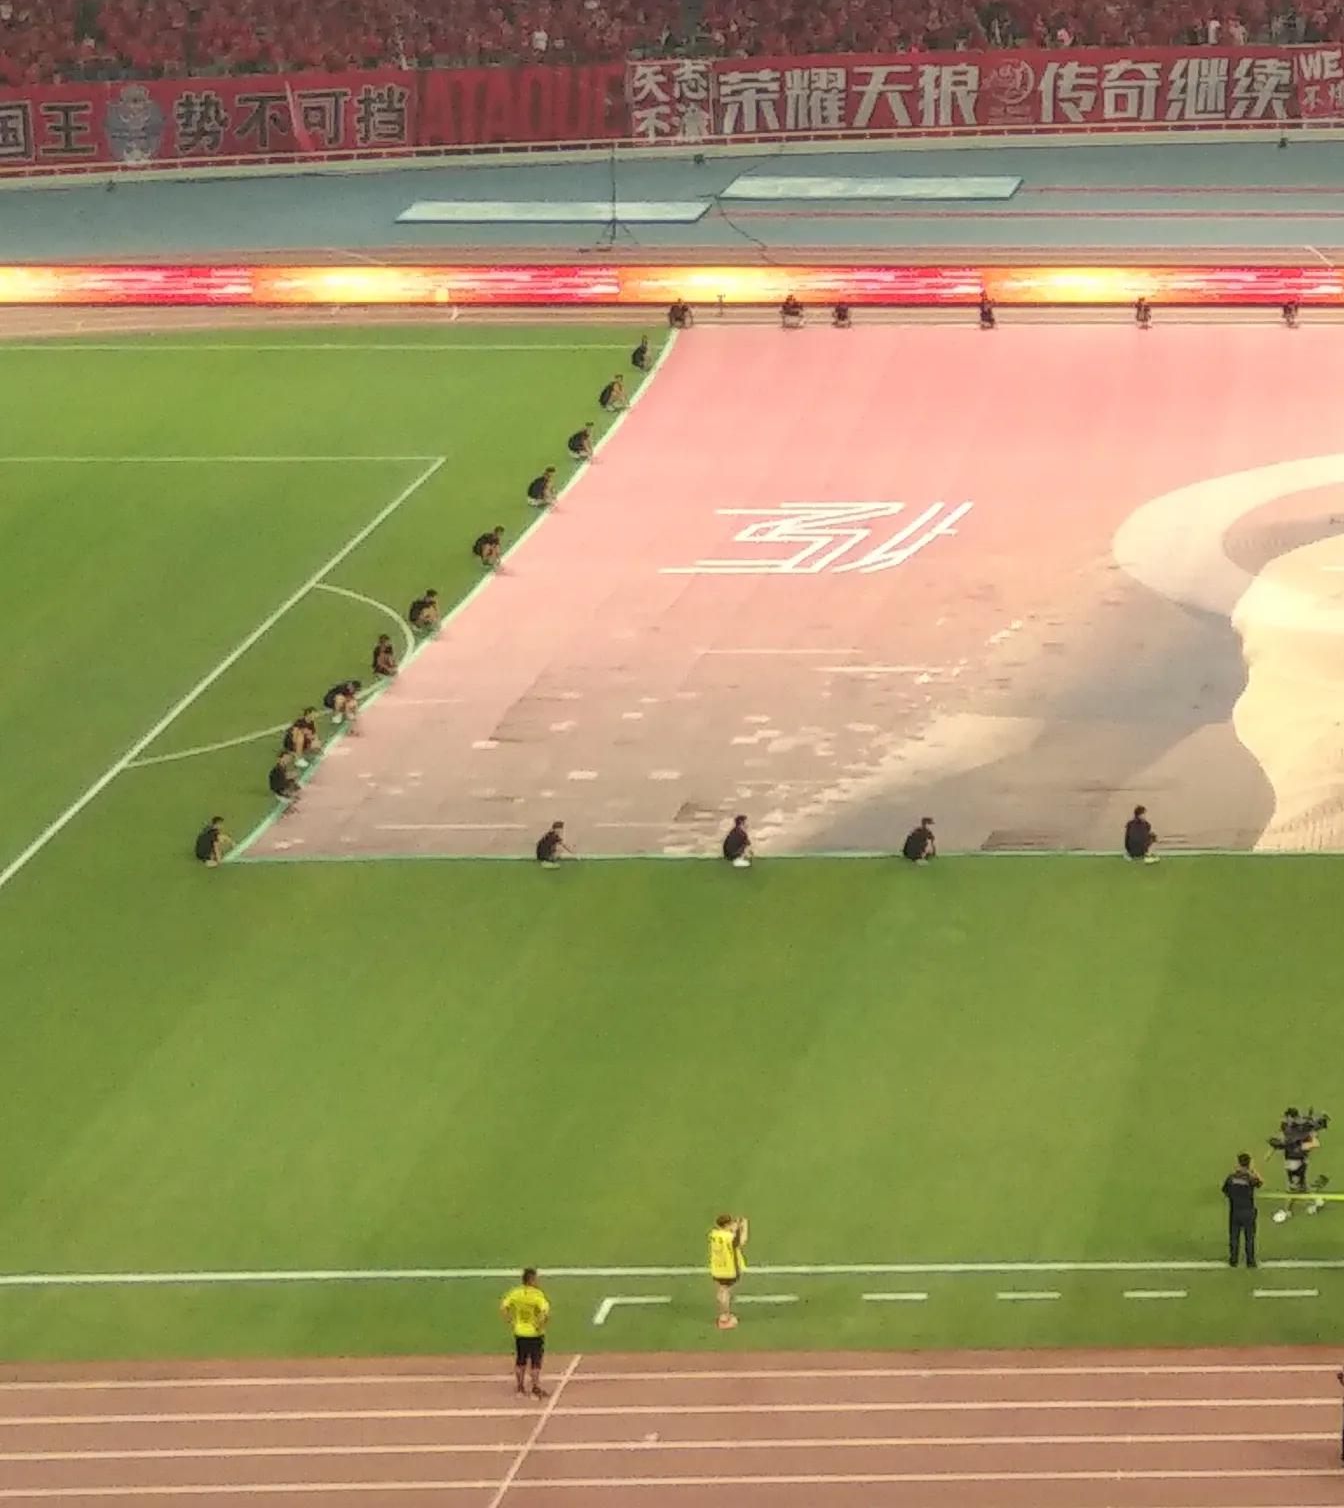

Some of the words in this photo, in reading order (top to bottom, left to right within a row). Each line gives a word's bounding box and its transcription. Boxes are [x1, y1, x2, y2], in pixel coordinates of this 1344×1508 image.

[718, 62, 979, 134] 荣耀天狼
[1039, 56, 1294, 124] 传奇继续
[1299, 48, 1344, 82] WE
[174, 82, 410, 156] 势不可挡
